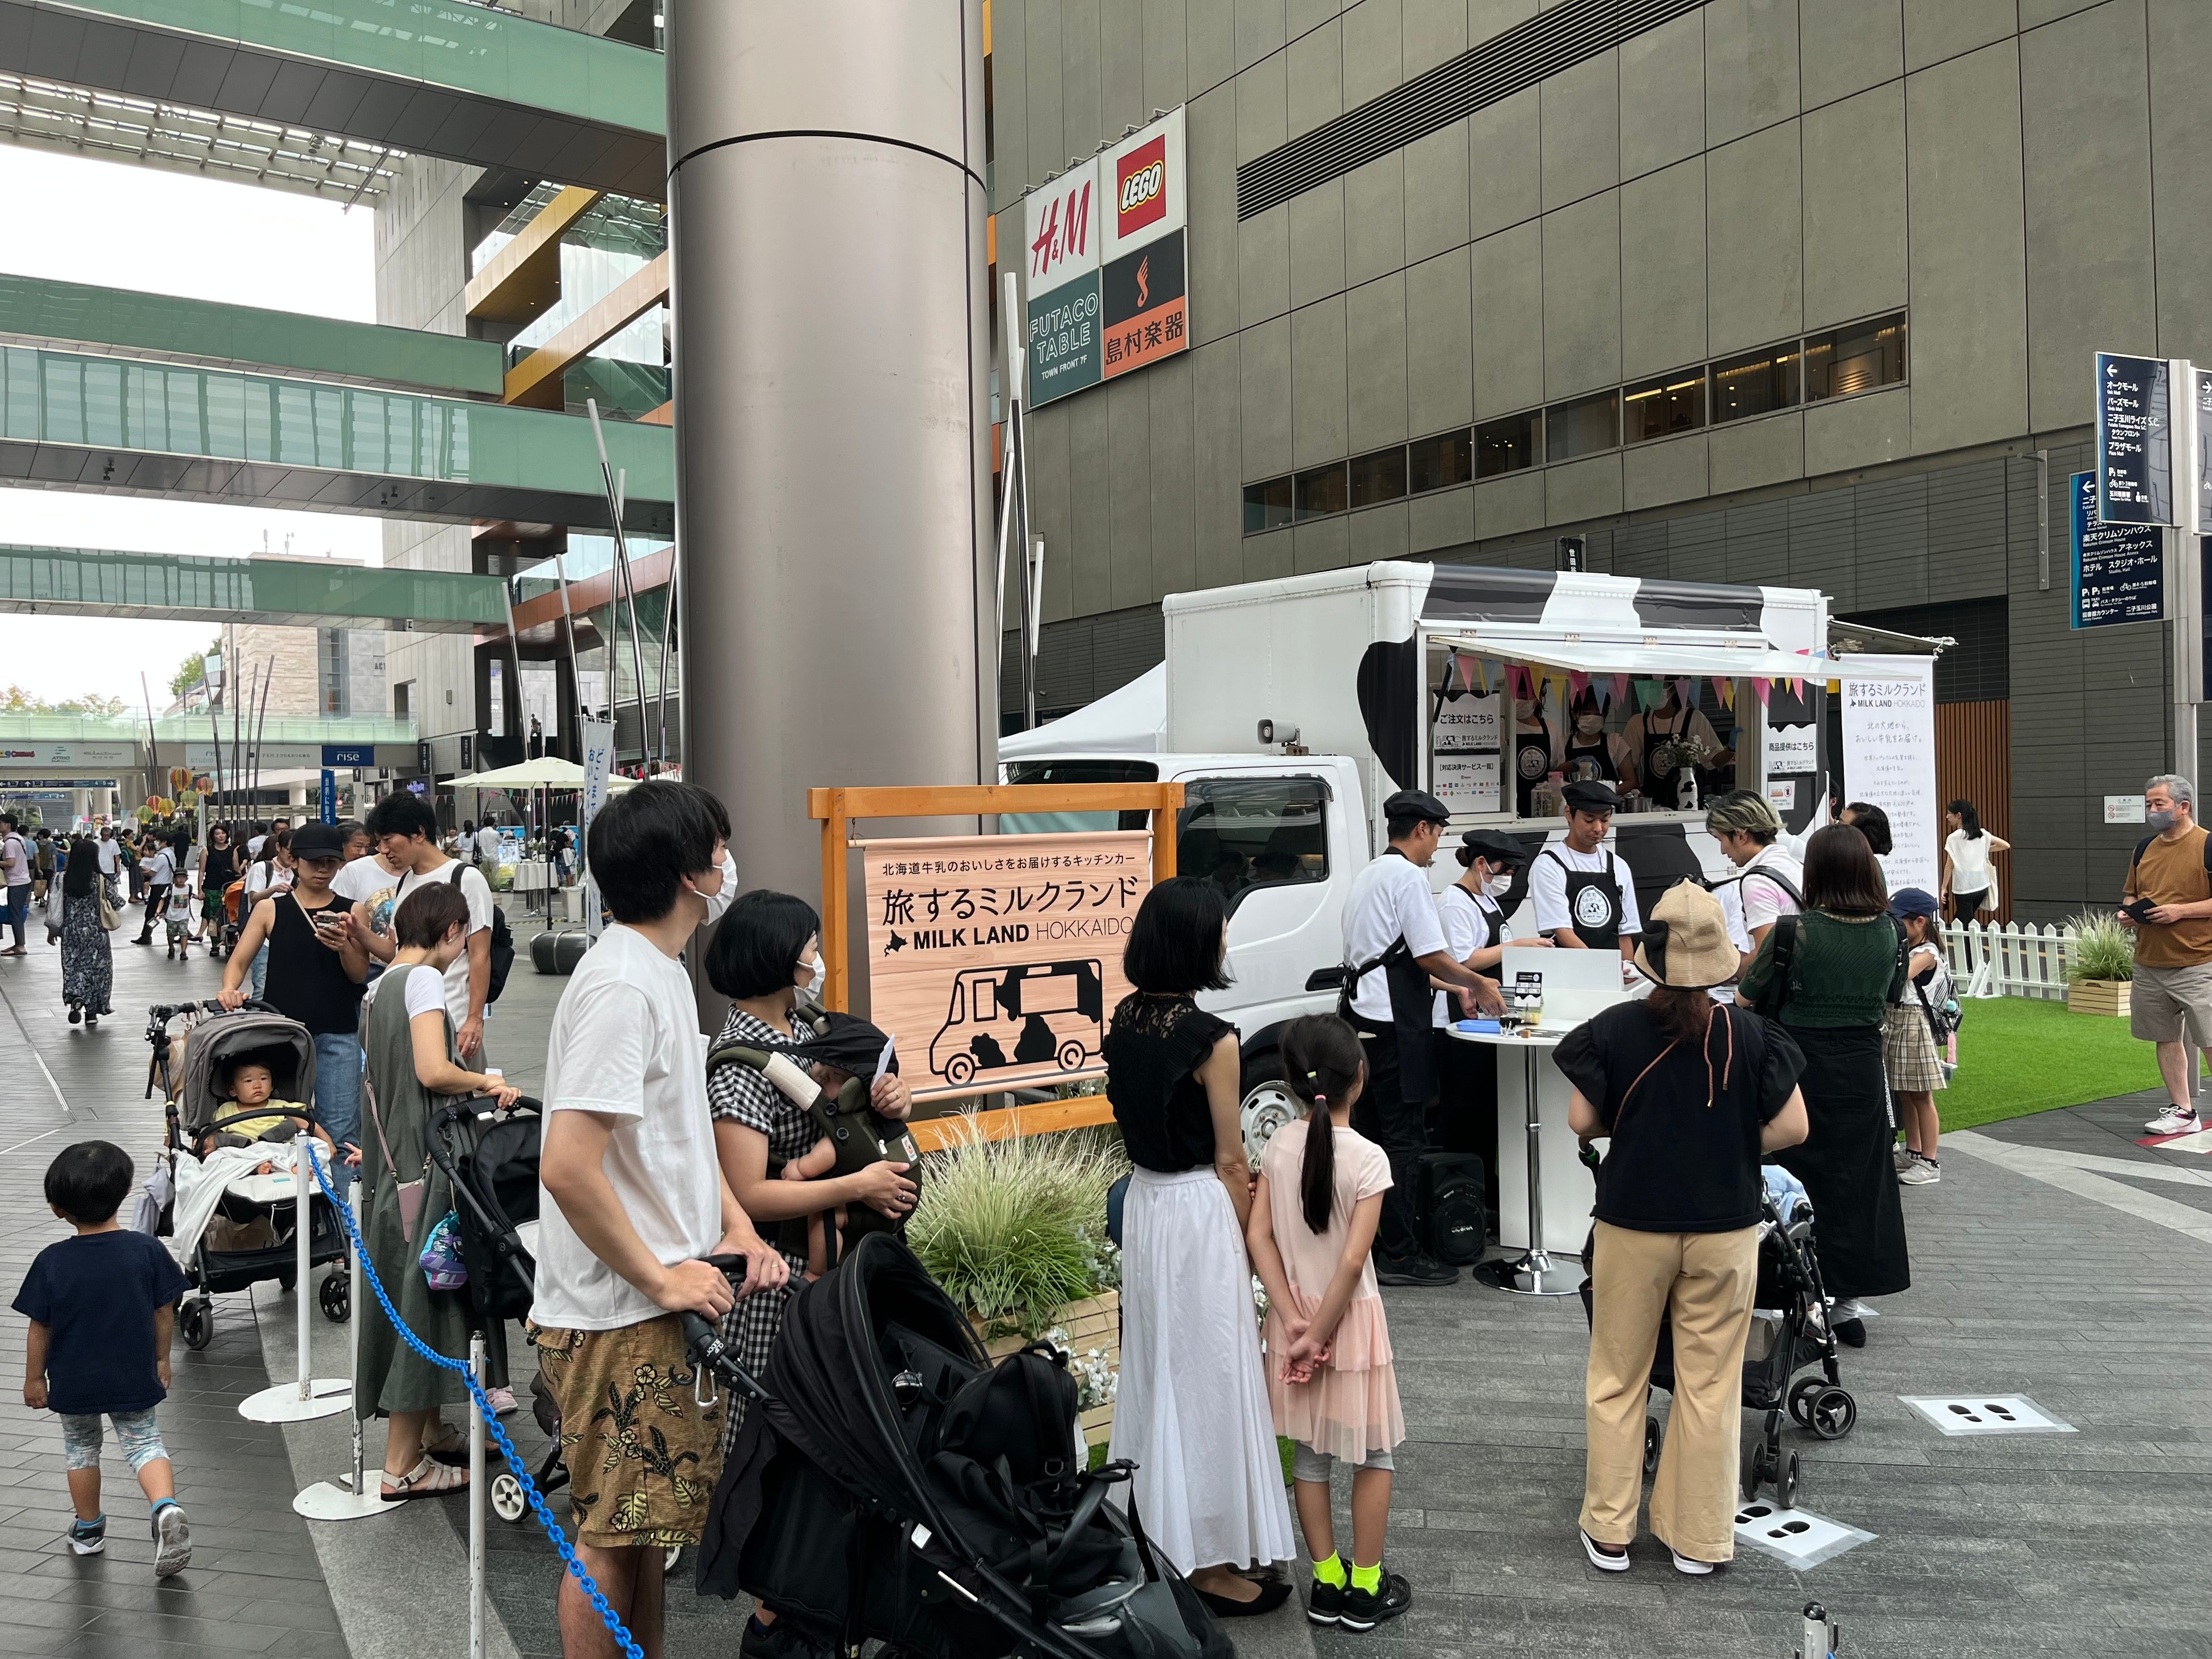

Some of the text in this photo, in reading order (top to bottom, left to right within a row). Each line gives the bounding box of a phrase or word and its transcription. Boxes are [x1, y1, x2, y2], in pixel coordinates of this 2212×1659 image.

[1119, 160, 1163, 213] LEGO
[1032, 179, 1091, 278] H&M
[1029, 293, 1098, 343] FUTACO
[1036, 322, 1091, 364] TABLE
[1106, 310, 1184, 366] 島村楽器
[1041, 354, 1087, 380] TOWN FRONT 7F
[2107, 381, 2138, 392] オークモール
[2107, 397, 2139, 408] バーズモール
[2108, 413, 2147, 425] 二子玉川ライズ
[2111, 428, 2140, 438] タウンフロント
[2108, 441, 2142, 453] プラザモール
[2083, 525, 2151, 543] 楽天クリムゾンハウス
[2118, 540, 2153, 552] アネックス
[2083, 555, 2158, 572] ホテル スタジオ・ホール
[1849, 682, 1926, 697] 旅するミルクランド
[1893, 699, 1925, 708] HOKKAIDO
[1440, 714, 1494, 724] ご注文はこちら
[1768, 742, 1814, 752] 商品提供はこちら
[882, 853, 1136, 876] 北海道牛乳のおいしさをお届けするキッチンカー
[882, 876, 1138, 926] 旅するミルクランド
[913, 916, 1135, 950] MILK LAND HOKKAIDO
